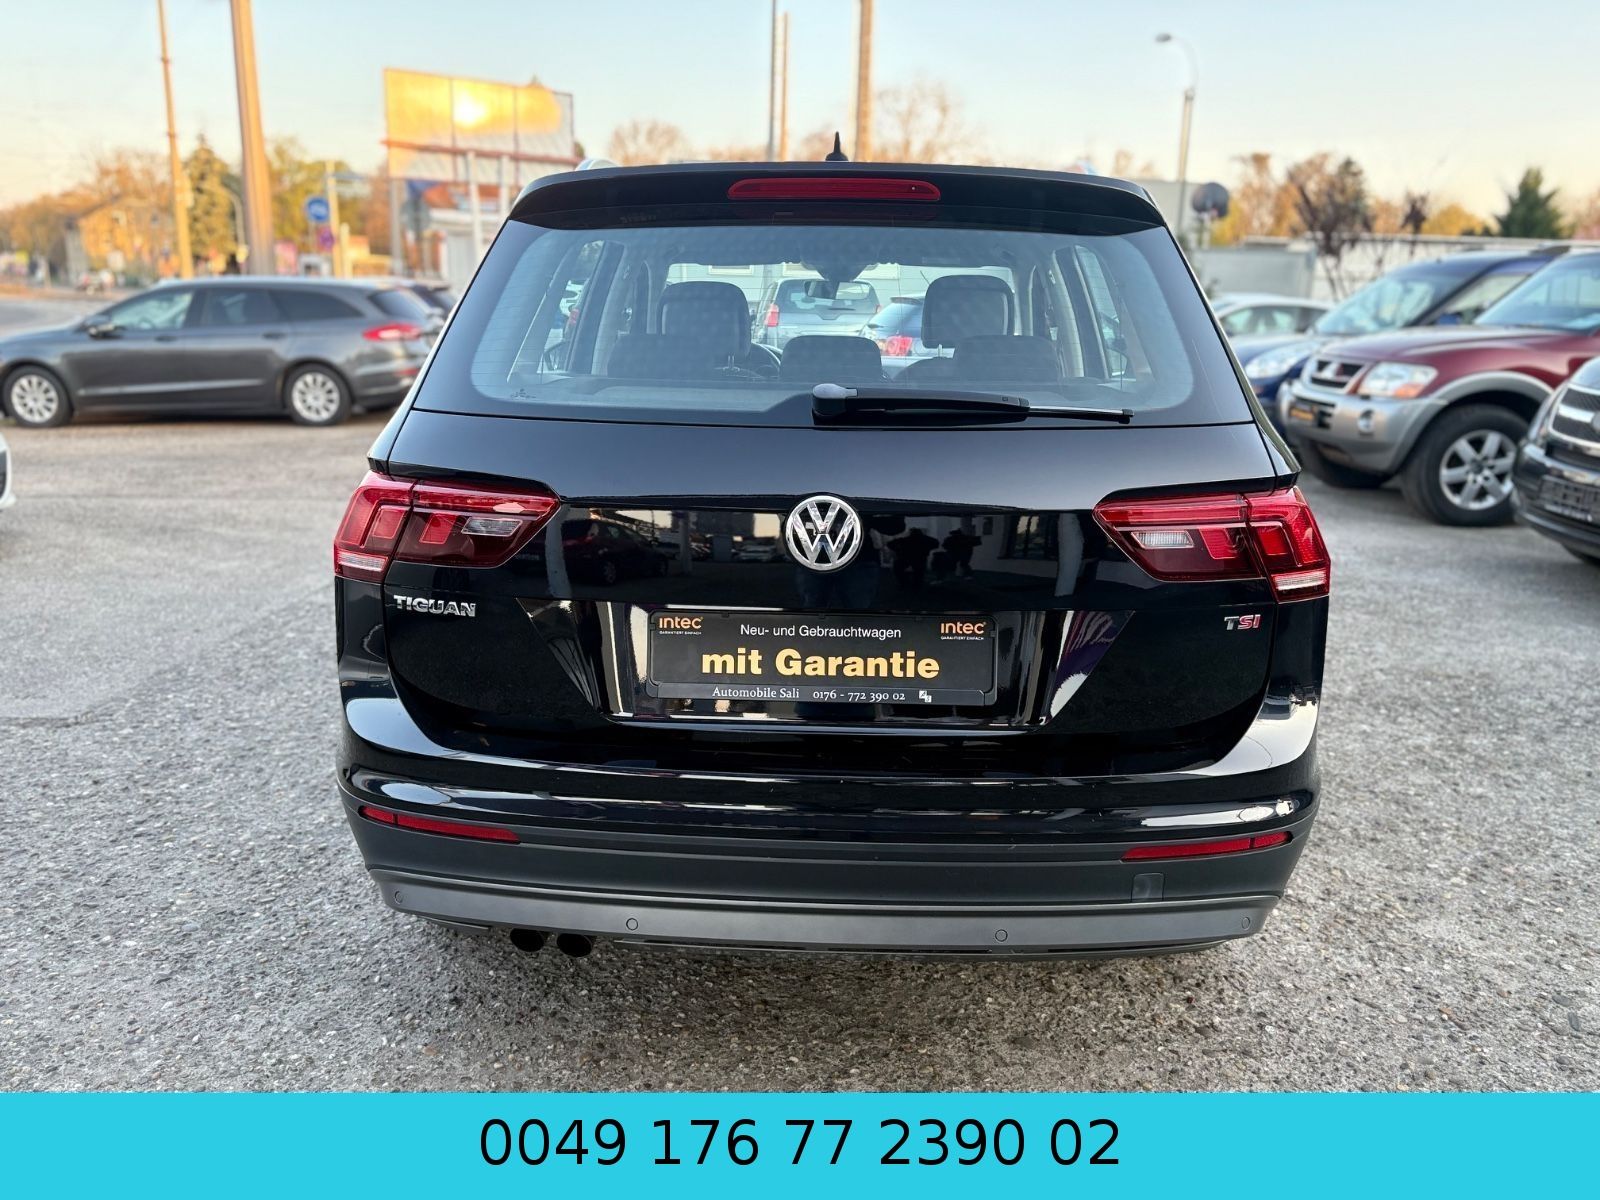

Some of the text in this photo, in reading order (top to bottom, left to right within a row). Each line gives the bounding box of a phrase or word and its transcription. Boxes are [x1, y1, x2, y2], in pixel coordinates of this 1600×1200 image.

[393, 594, 477, 618] TIGUAN
[659, 616, 702, 630] intec
[940, 621, 985, 634] intec
[1223, 614, 1261, 631] TSI
[740, 624, 902, 641] Neu- und Gebrauchtwagen
[702, 647, 941, 679] mit Garantie
[712, 686, 800, 698] Automobile Sali
[812, 689, 838, 702] 0176
[847, 692, 867, 702] 772
[869, 692, 890, 703] 390
[892, 692, 906, 701] 02
